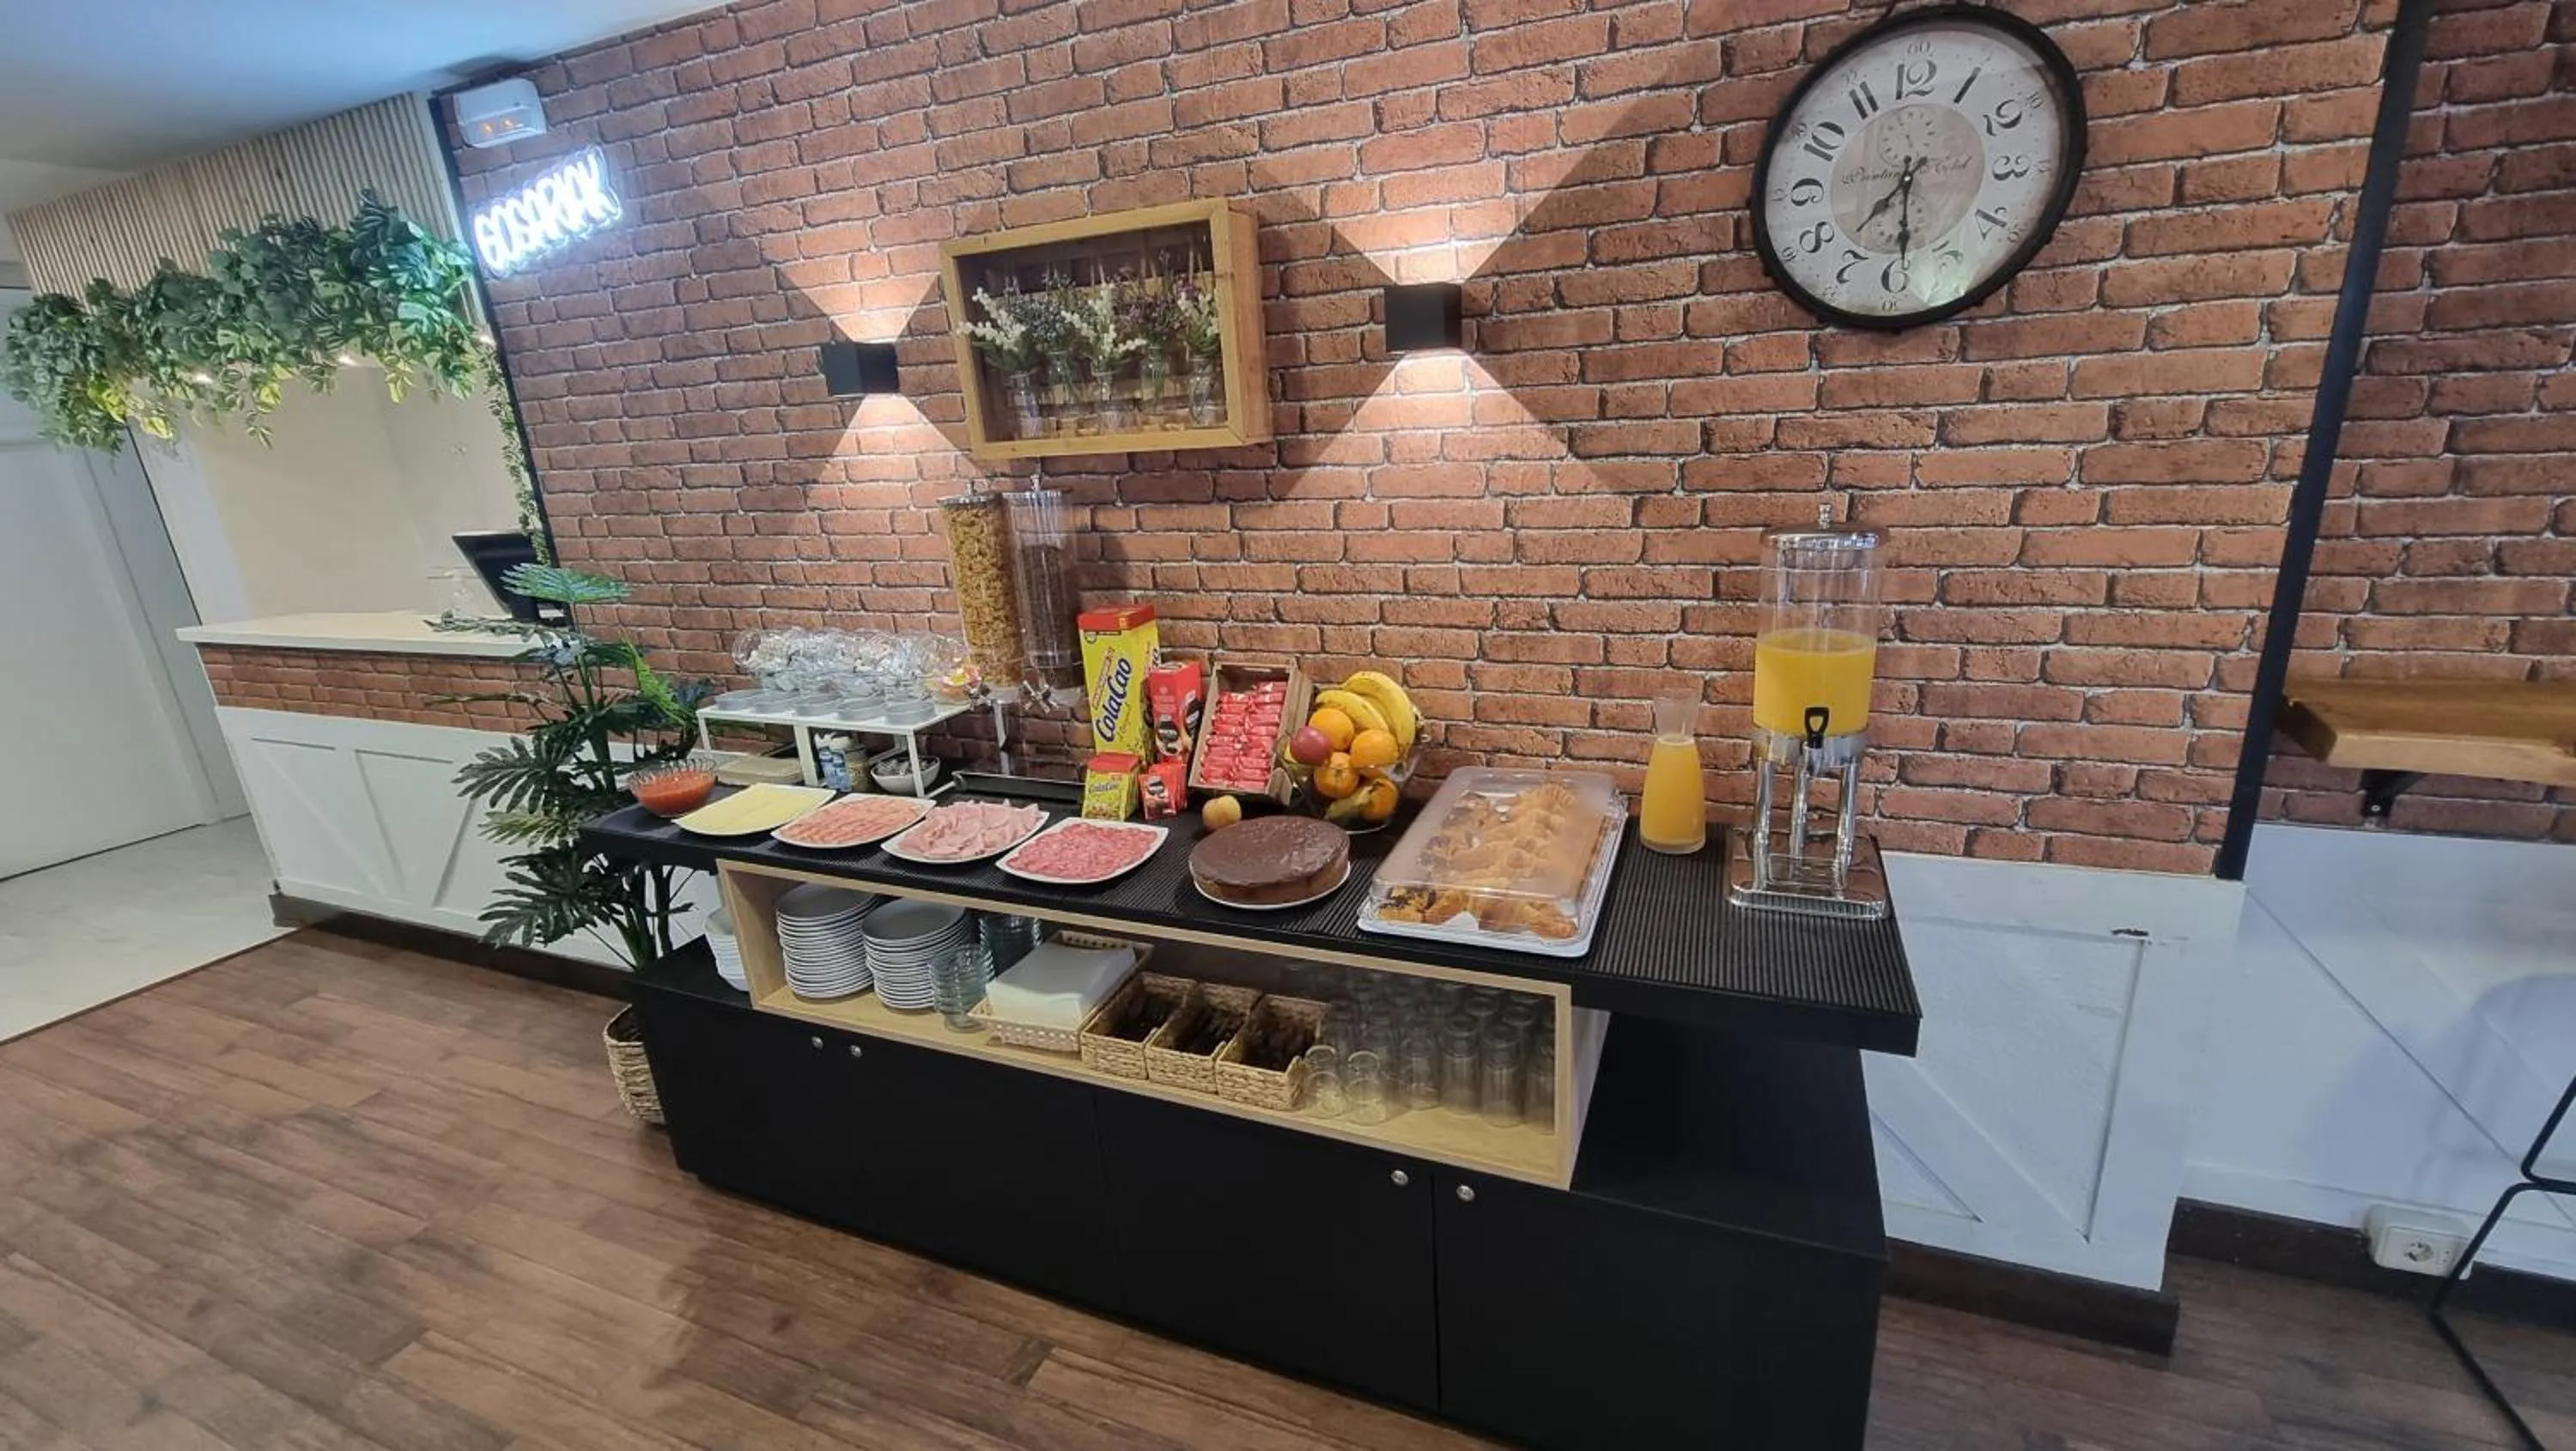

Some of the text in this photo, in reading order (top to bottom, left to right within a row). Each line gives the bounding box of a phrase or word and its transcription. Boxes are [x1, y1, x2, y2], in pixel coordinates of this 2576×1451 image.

[1895, 59, 1937, 100] 12
[1953, 66, 1982, 104] 1
[1849, 81, 1880, 120] 11
[1983, 99, 2023, 137] 2
[1803, 121, 1845, 161] 10
[1991, 155, 2032, 182] 3
[1790, 178, 1825, 207] 9
[1799, 221, 1835, 254] 8
[1975, 206, 2008, 241] 4
[1836, 250, 1869, 285] 7
[1932, 240, 1964, 271] 5
[1880, 258, 1911, 293] 6
[1095, 657, 1133, 744] ColaCao
